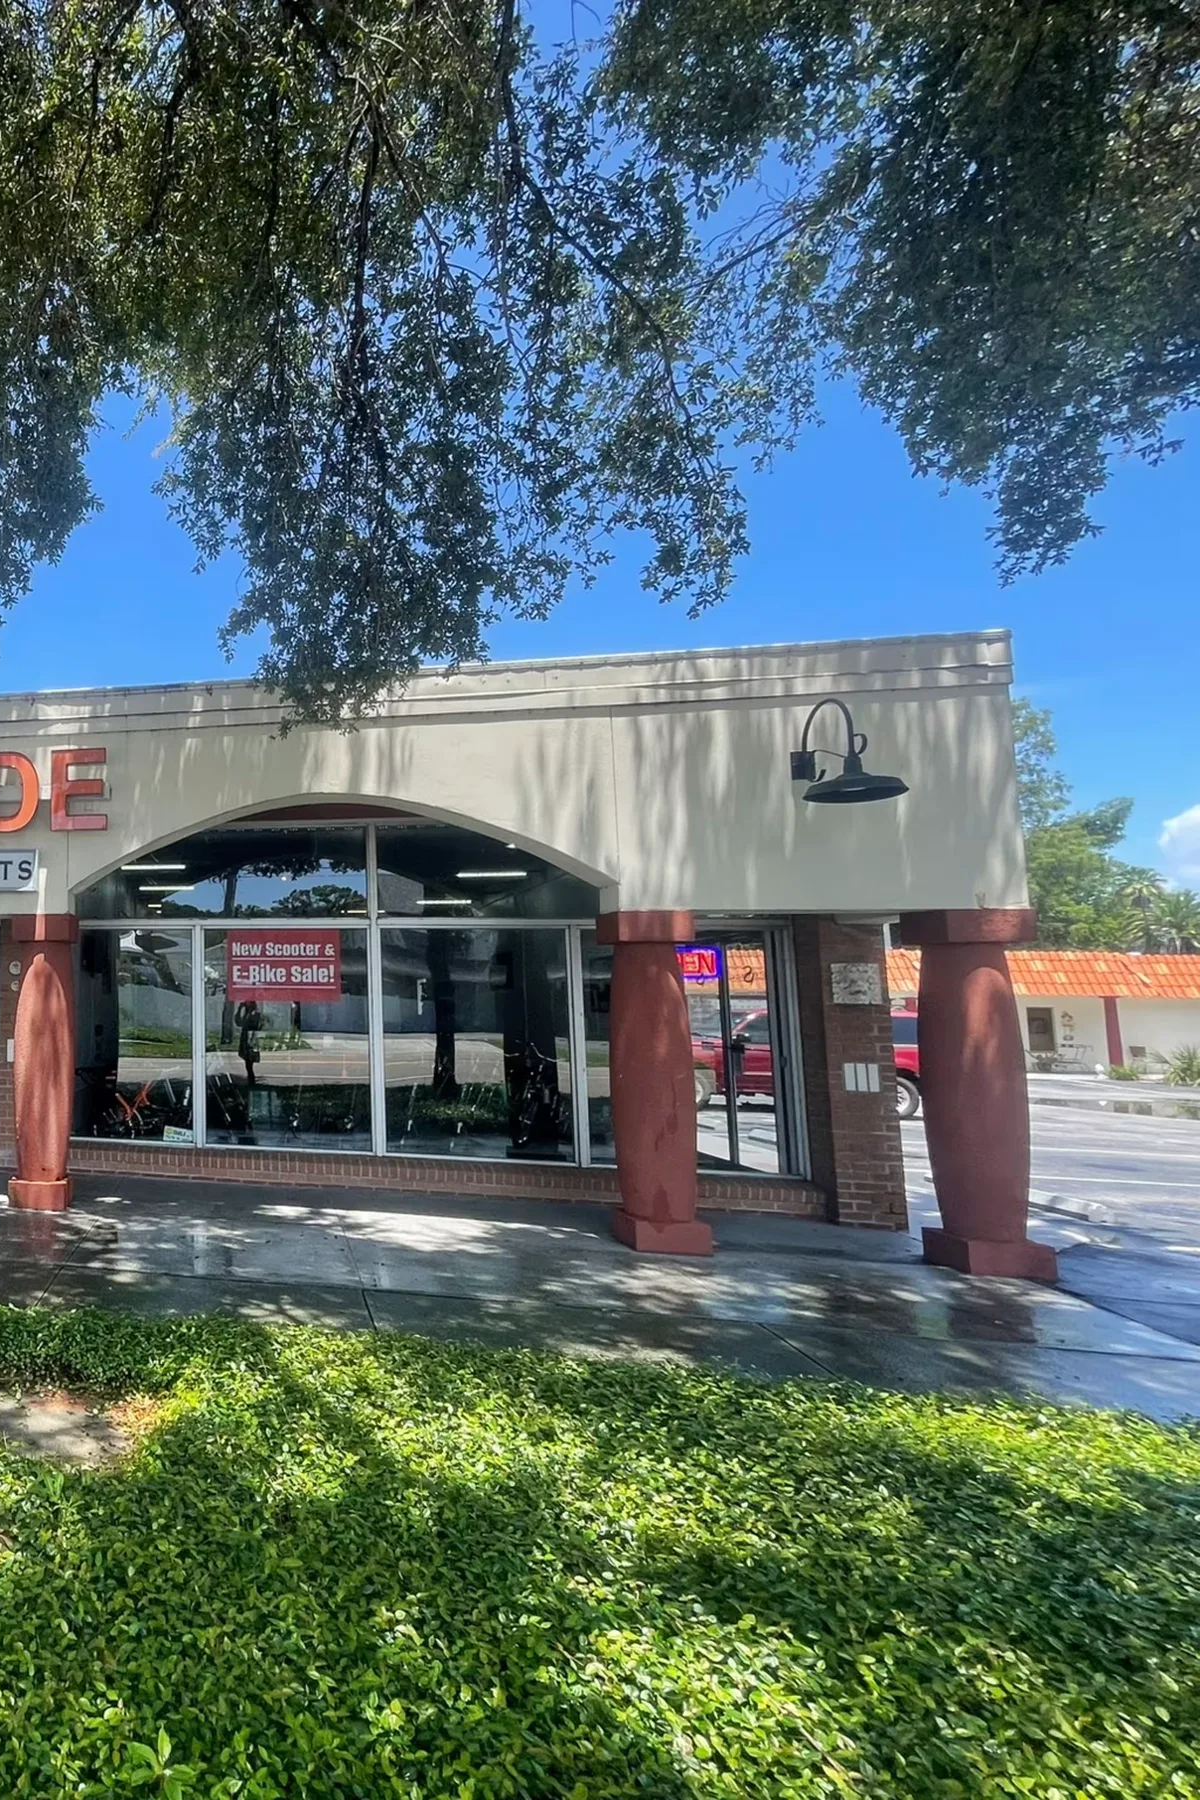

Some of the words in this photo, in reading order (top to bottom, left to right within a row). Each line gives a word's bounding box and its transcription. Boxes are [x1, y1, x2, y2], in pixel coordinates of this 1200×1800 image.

[232, 942, 262, 956] New
[265, 941, 321, 956] Scooter
[324, 943, 336, 956] &
[232, 963, 287, 983] E-Bike
[290, 964, 335, 983] Sale!
